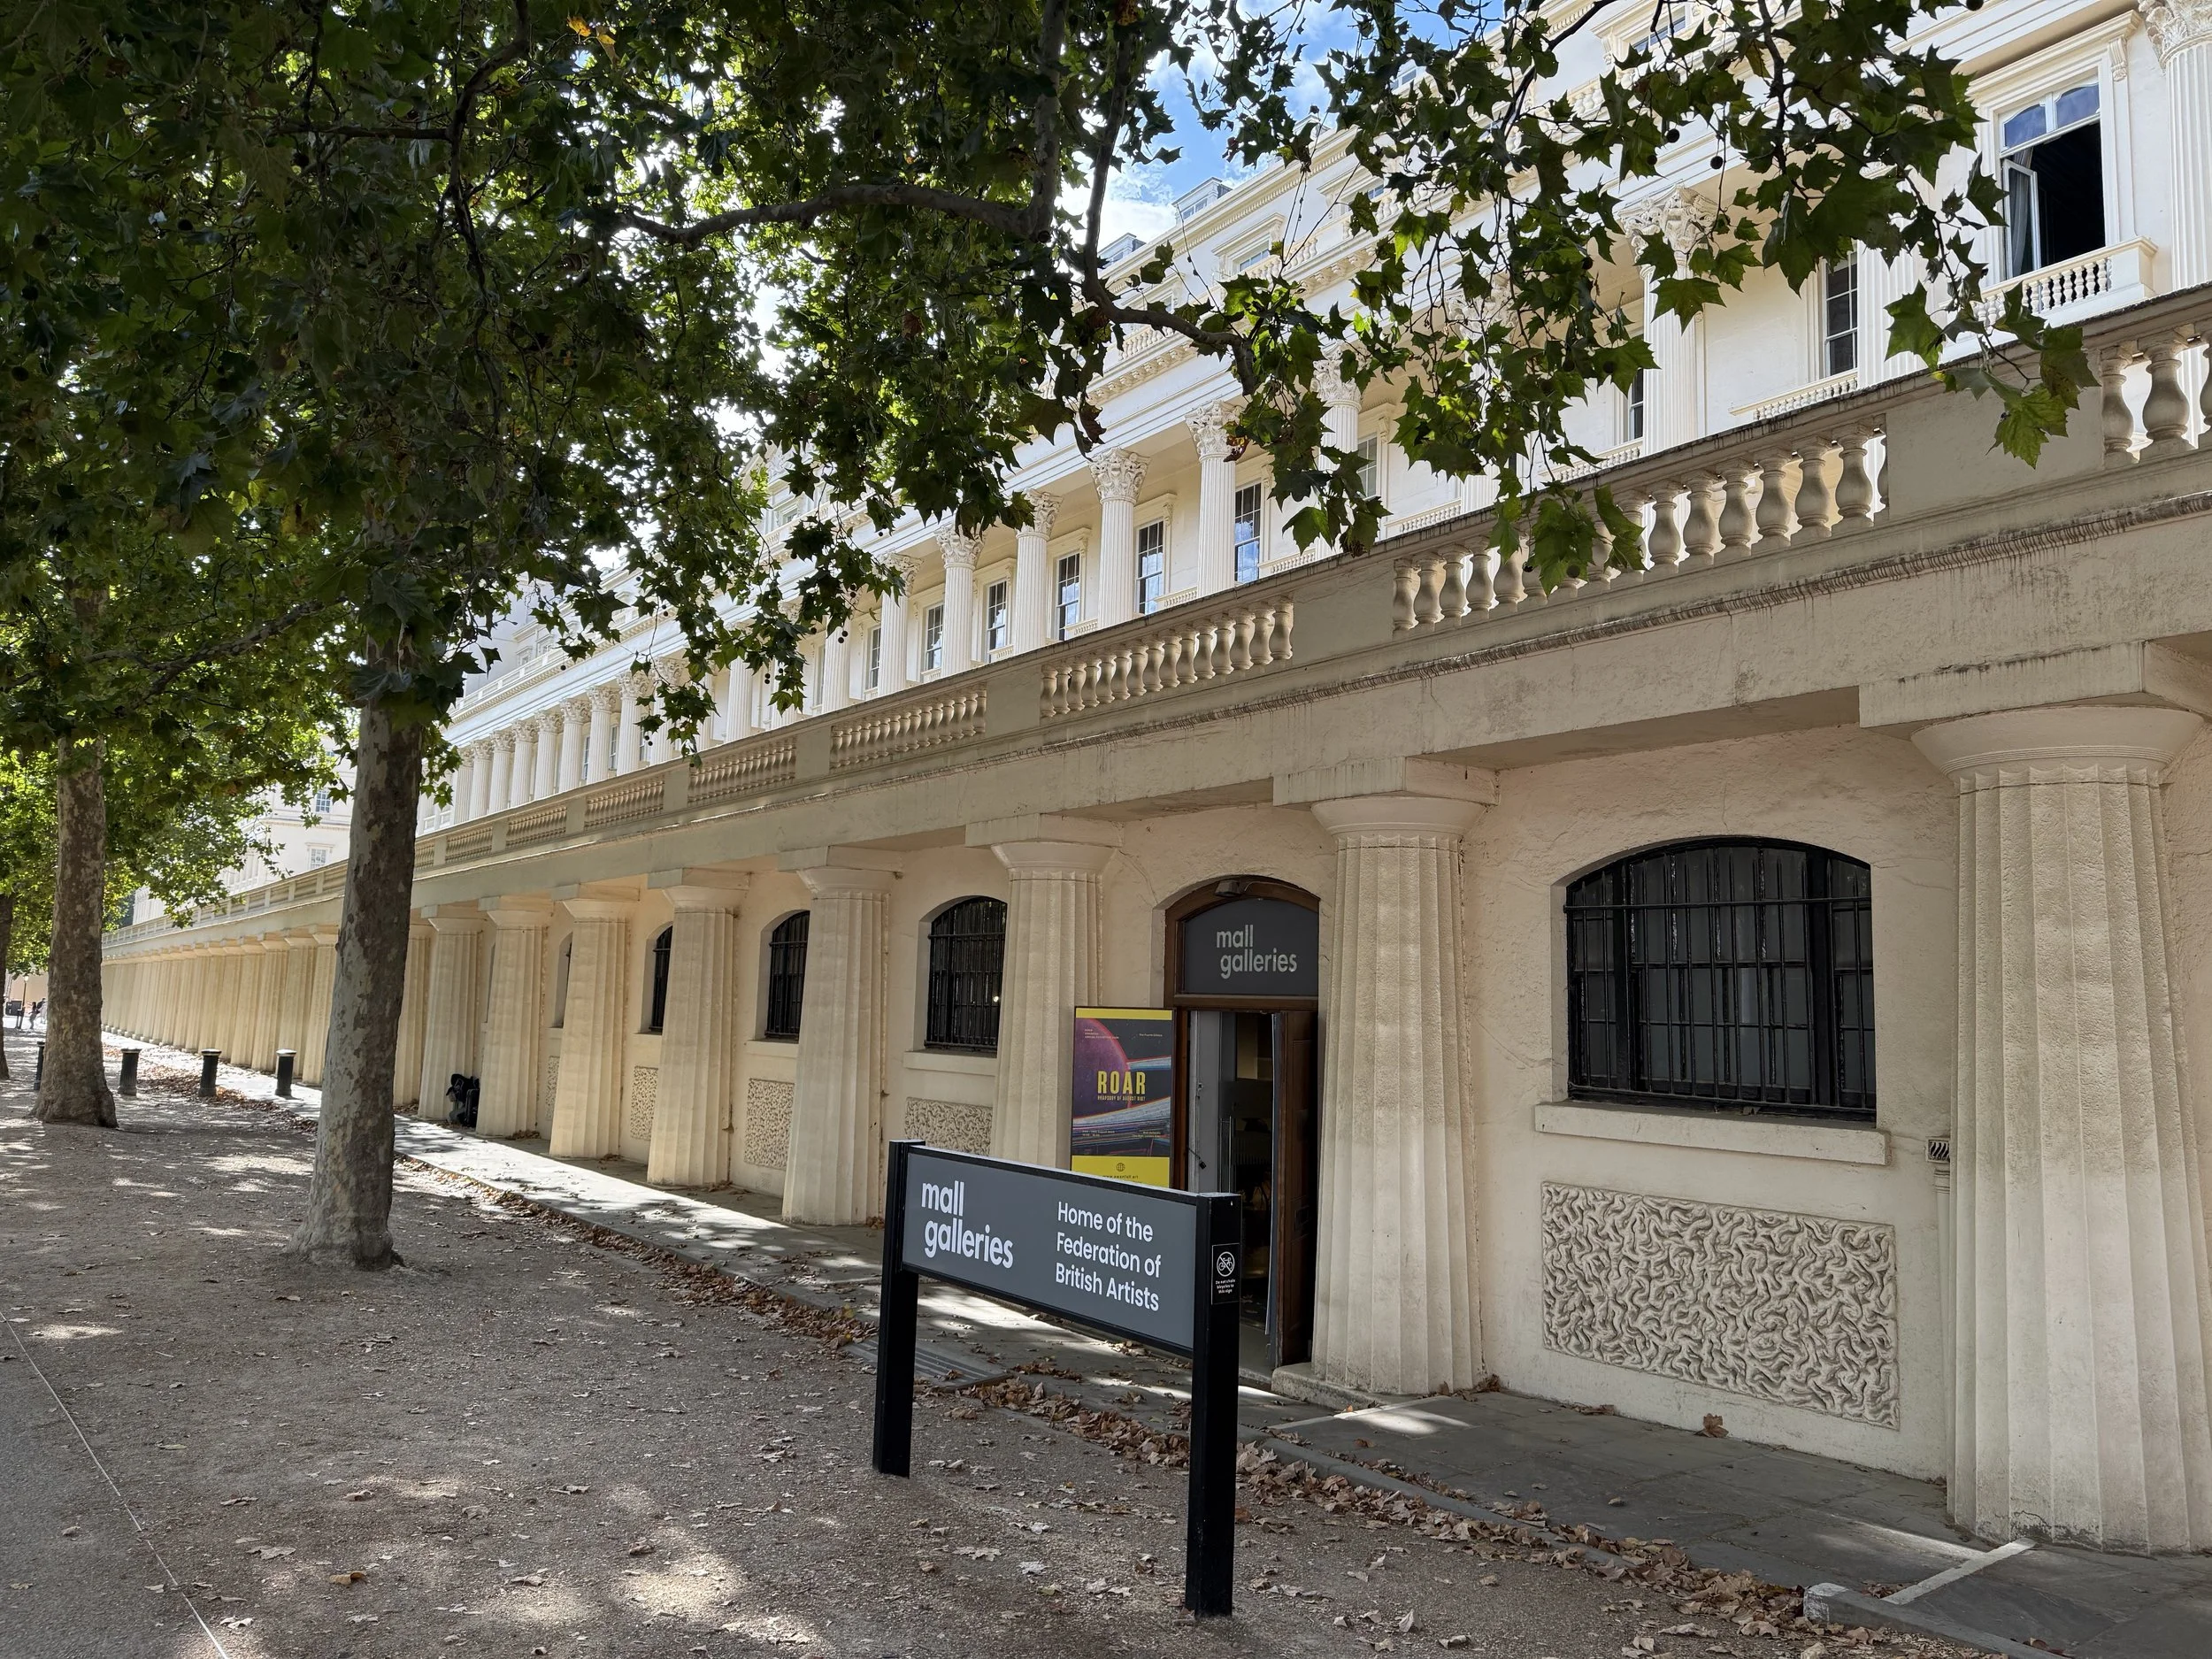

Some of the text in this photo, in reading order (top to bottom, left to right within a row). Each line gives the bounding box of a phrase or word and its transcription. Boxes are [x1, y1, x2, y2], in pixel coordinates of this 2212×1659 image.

[1217, 925, 1254, 948] mall
[1220, 949, 1297, 979] galleries
[1097, 1071, 1146, 1094] ROAR
[921, 1180, 964, 1217] mall
[1057, 1202, 1153, 1242] Home of the
[924, 1217, 1013, 1268] galleries
[1056, 1232, 1162, 1278] Federation of
[1056, 1262, 1159, 1311] British Artists
